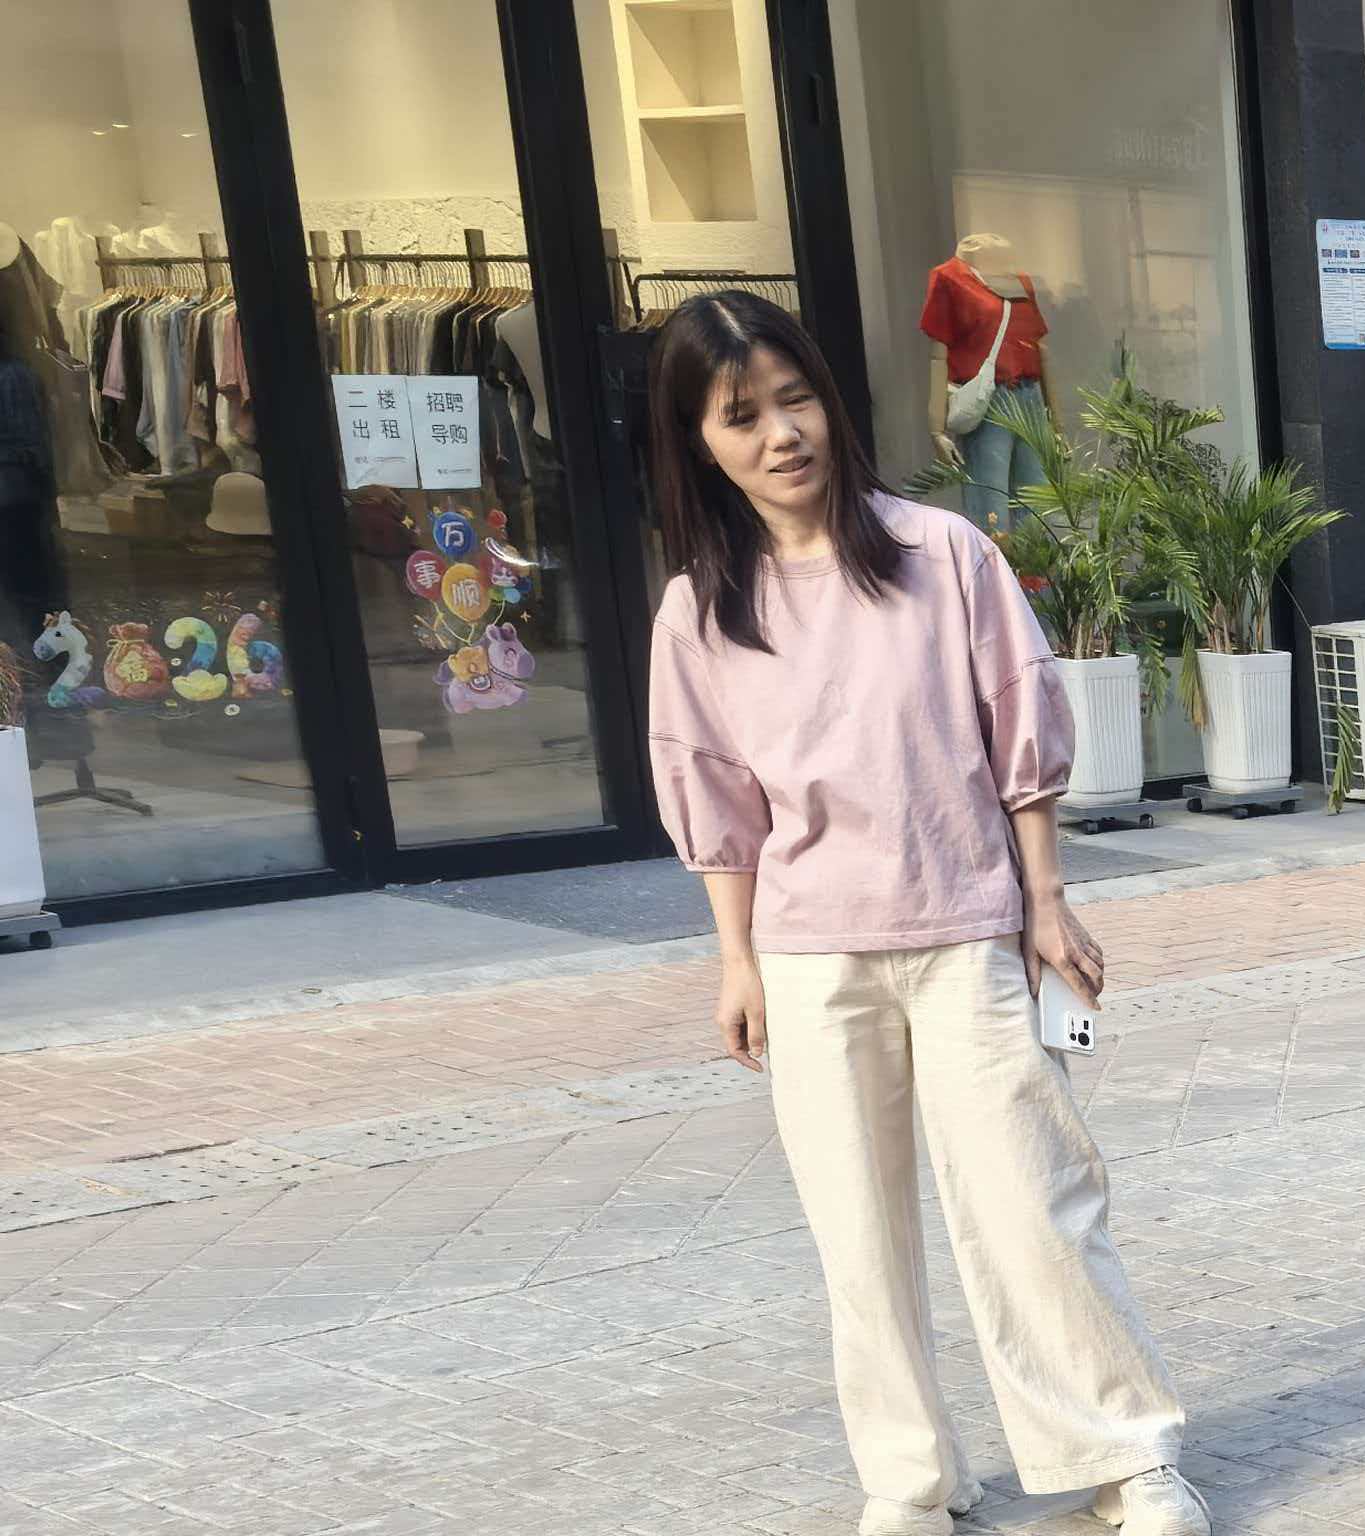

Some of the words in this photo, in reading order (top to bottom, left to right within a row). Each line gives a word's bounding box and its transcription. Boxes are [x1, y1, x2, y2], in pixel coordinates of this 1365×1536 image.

[348, 389, 396, 410] 二楼
[426, 392, 464, 413] 招聘
[352, 419, 400, 440] 出租
[432, 424, 468, 445] 导购
[442, 521, 464, 547] 万
